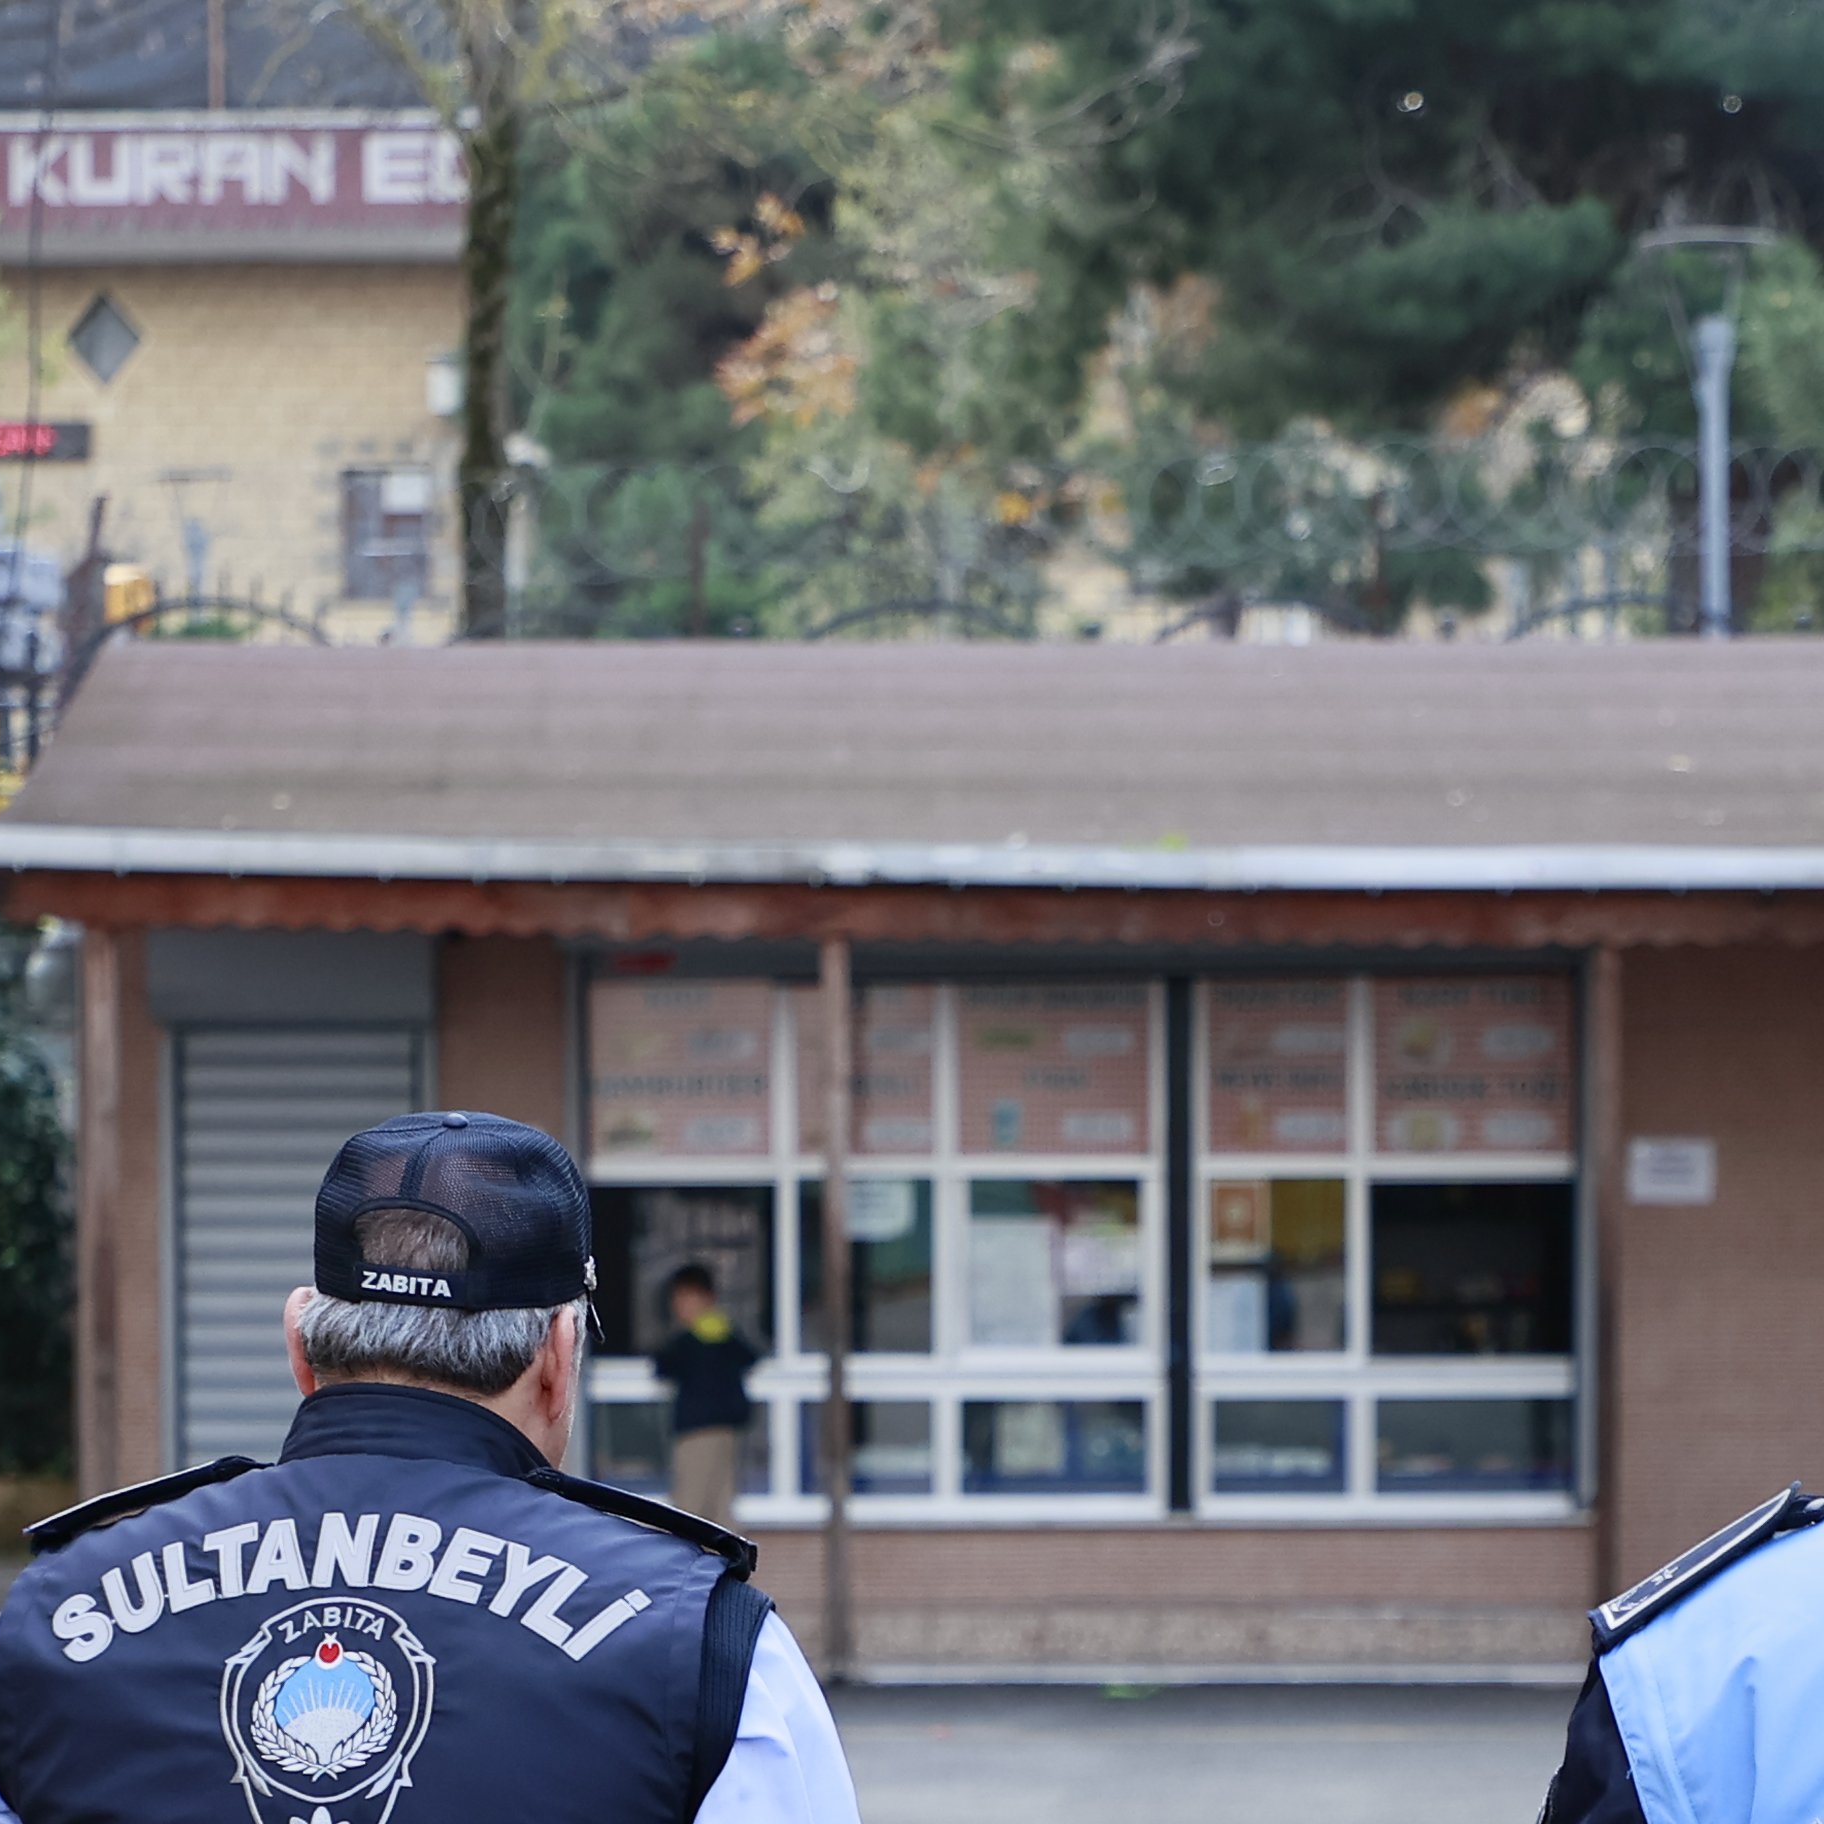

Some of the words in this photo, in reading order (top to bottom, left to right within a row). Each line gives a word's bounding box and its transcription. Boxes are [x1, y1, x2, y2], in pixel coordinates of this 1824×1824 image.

[7, 132, 337, 207] KURAN
[361, 1271, 452, 1299] ZABITA
[277, 1606, 386, 1644] ZABITA
